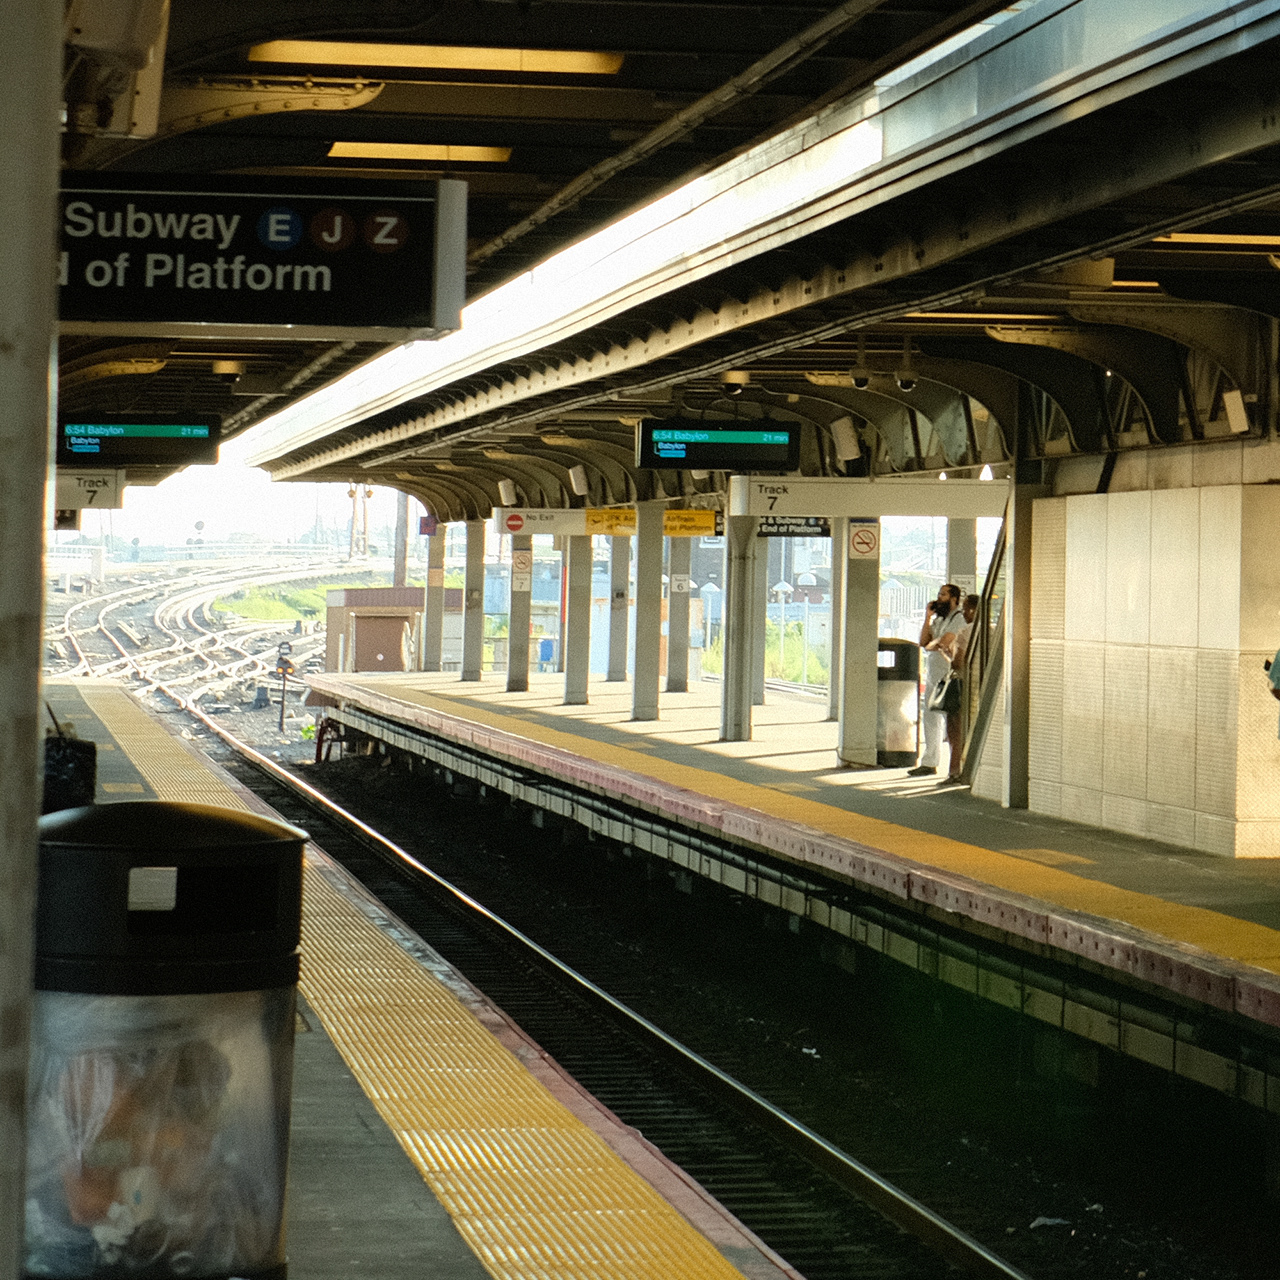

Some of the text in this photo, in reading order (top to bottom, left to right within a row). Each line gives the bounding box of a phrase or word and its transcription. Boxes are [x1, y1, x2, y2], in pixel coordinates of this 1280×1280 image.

[64, 201, 399, 249] Subway E J Z
[85, 253, 130, 287] of
[145, 253, 332, 291] Platform
[88, 425, 125, 436] Babylon
[70, 436, 100, 445] Babylon
[674, 431, 709, 442] Babylon
[658, 442, 687, 450] Babylon
[76, 477, 109, 489] Track
[757, 484, 789, 495] Track
[86, 489, 98, 505] 7
[767, 496, 778, 511] 7
[789, 525, 822, 533] Platform
[677, 583, 684, 591] 6
